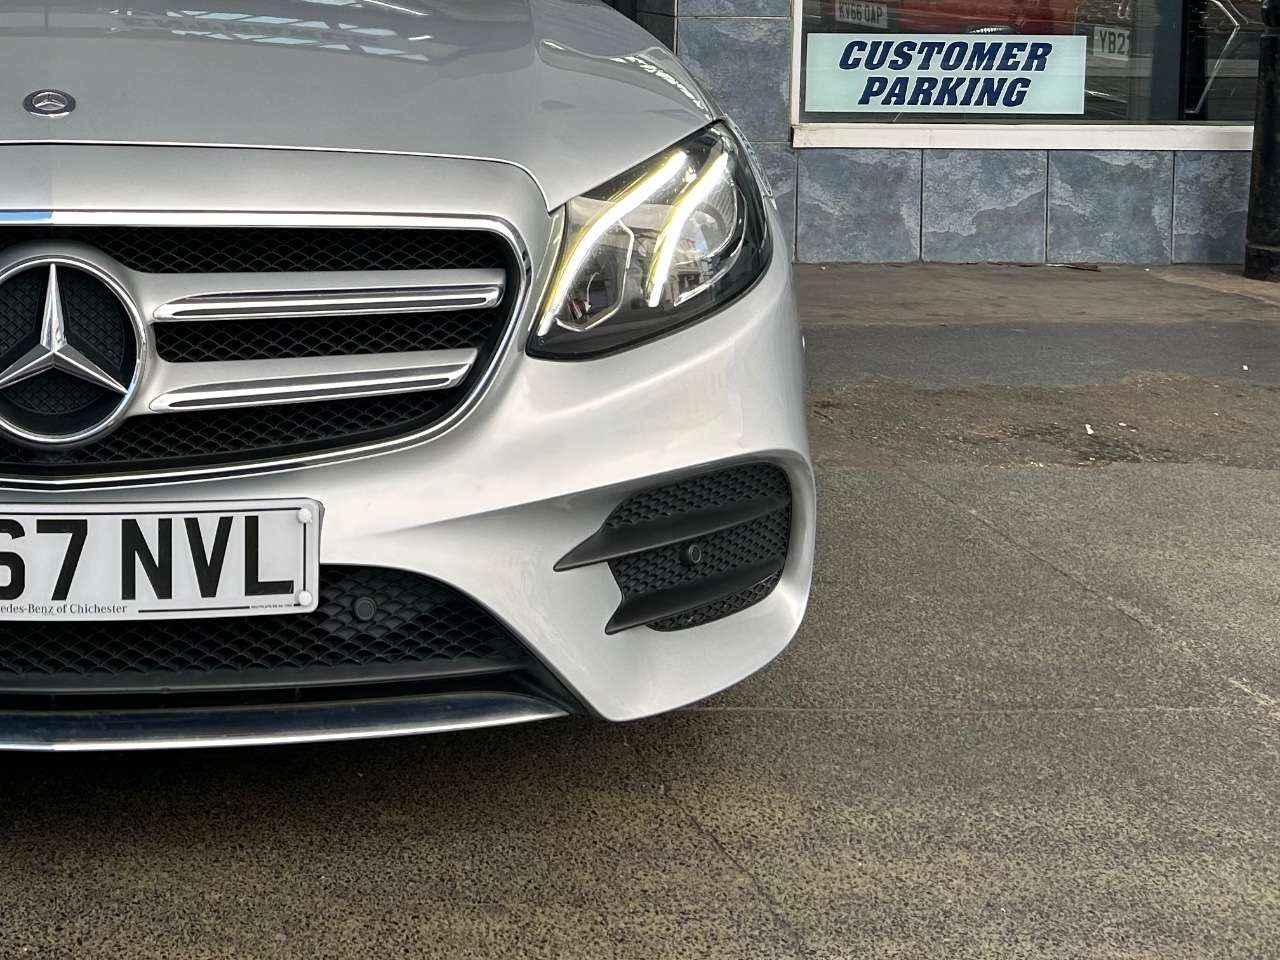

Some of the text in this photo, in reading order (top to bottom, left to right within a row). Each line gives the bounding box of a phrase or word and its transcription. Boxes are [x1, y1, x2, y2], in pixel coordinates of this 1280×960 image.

[839, 40, 1052, 72] CUSTOMER
[858, 76, 1031, 107] PARKING
[121, 515, 294, 601] NVL
[56, 602, 67, 613] of
[70, 602, 127, 614] Chichester
